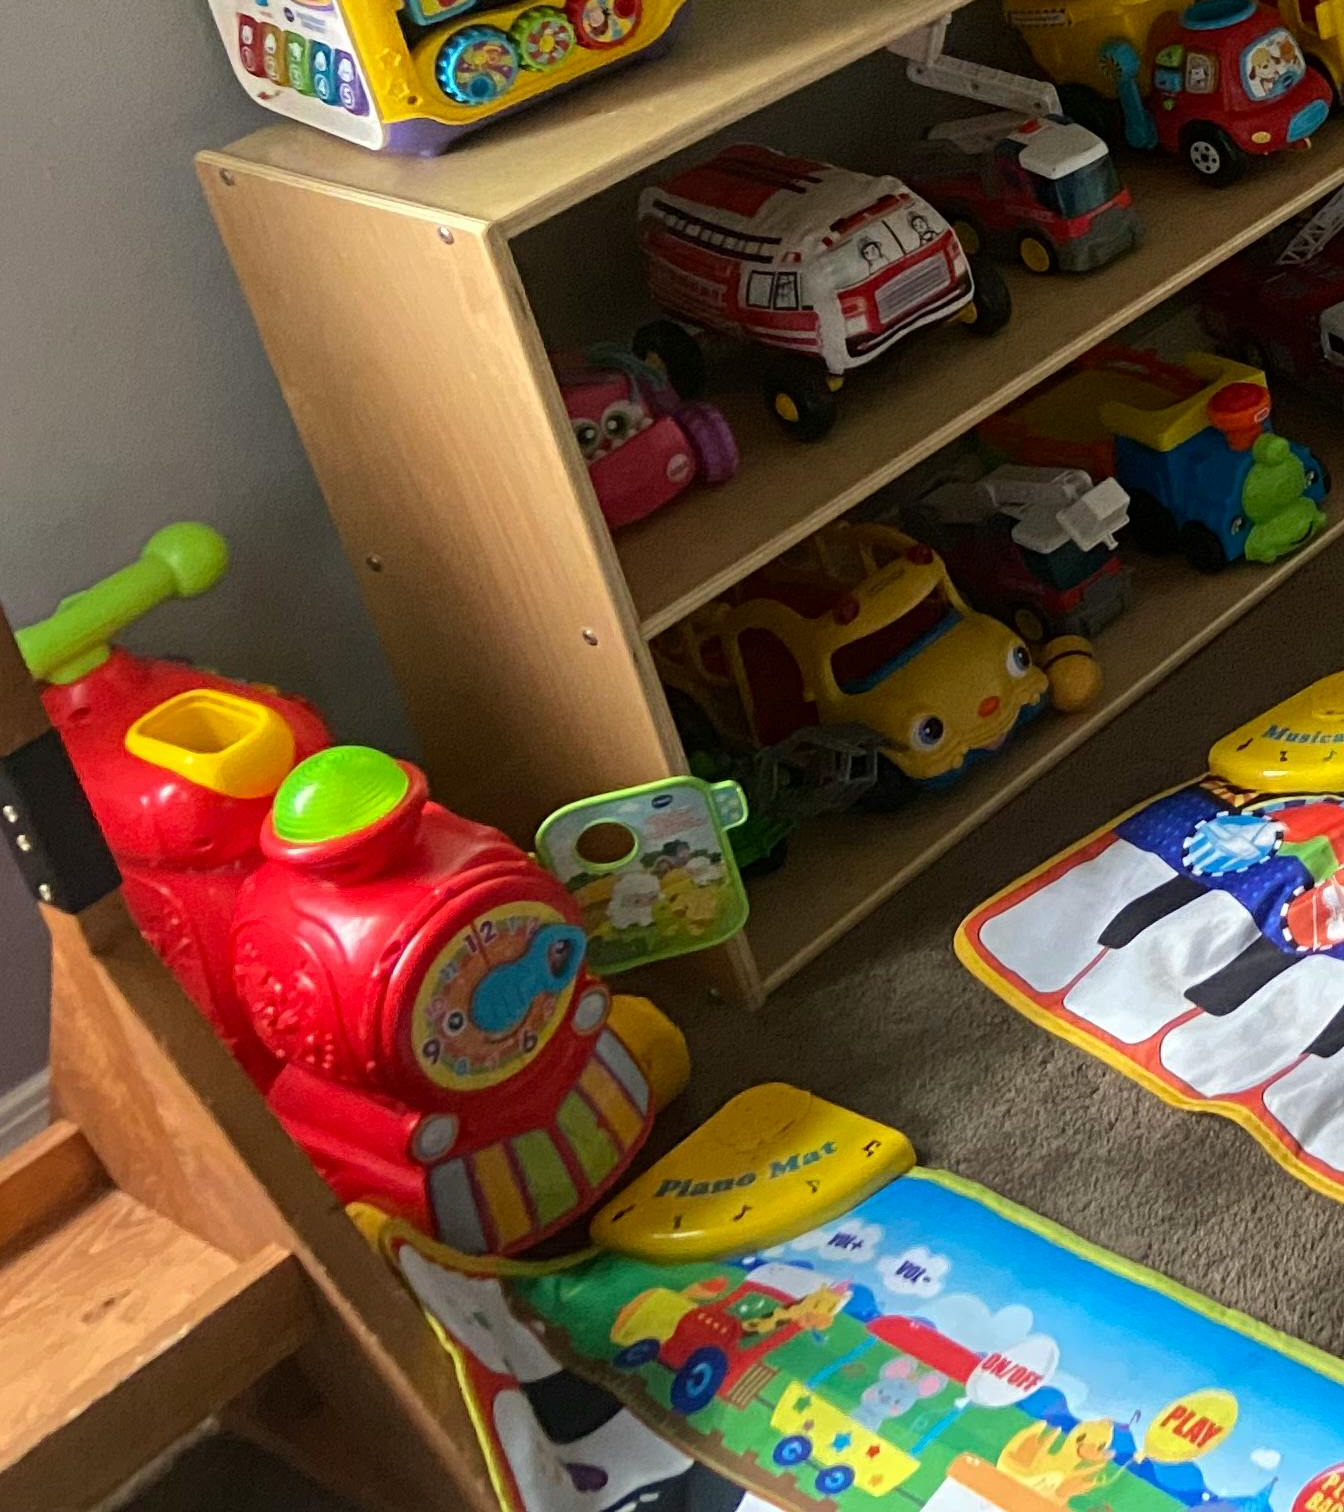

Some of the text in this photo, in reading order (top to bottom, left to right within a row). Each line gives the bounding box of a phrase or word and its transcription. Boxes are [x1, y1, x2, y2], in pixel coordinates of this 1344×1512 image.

[422, 1037, 442, 1066] 9
[654, 1139, 838, 1198] Piano Mat
[981, 1350, 1044, 1393] ON/OFF
[1160, 1404, 1225, 1448] PLAY
